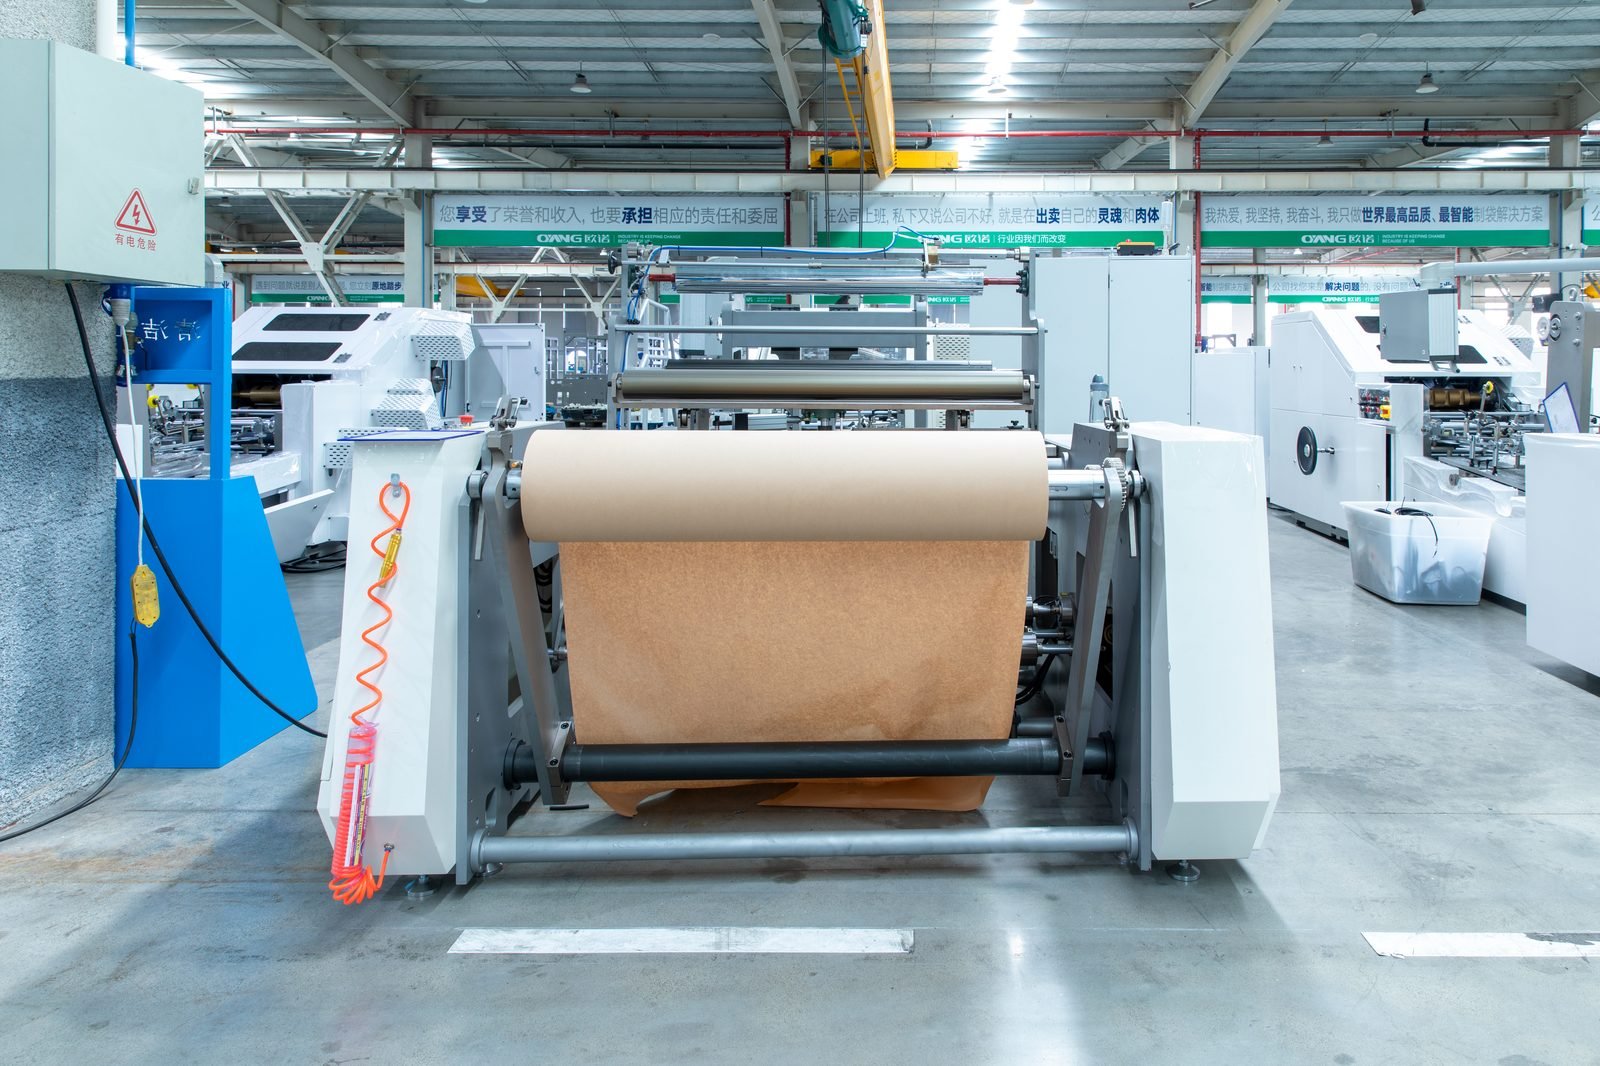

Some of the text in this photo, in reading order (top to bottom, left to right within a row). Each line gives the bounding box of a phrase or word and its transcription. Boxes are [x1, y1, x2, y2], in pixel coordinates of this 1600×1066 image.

[115, 233, 157, 251] 有电危险
[585, 234, 610, 243] 欧诺
[965, 234, 991, 244] 欧诺
[998, 234, 1067, 244] 行业因我们而改变
[1348, 234, 1375, 243] 欧诺
